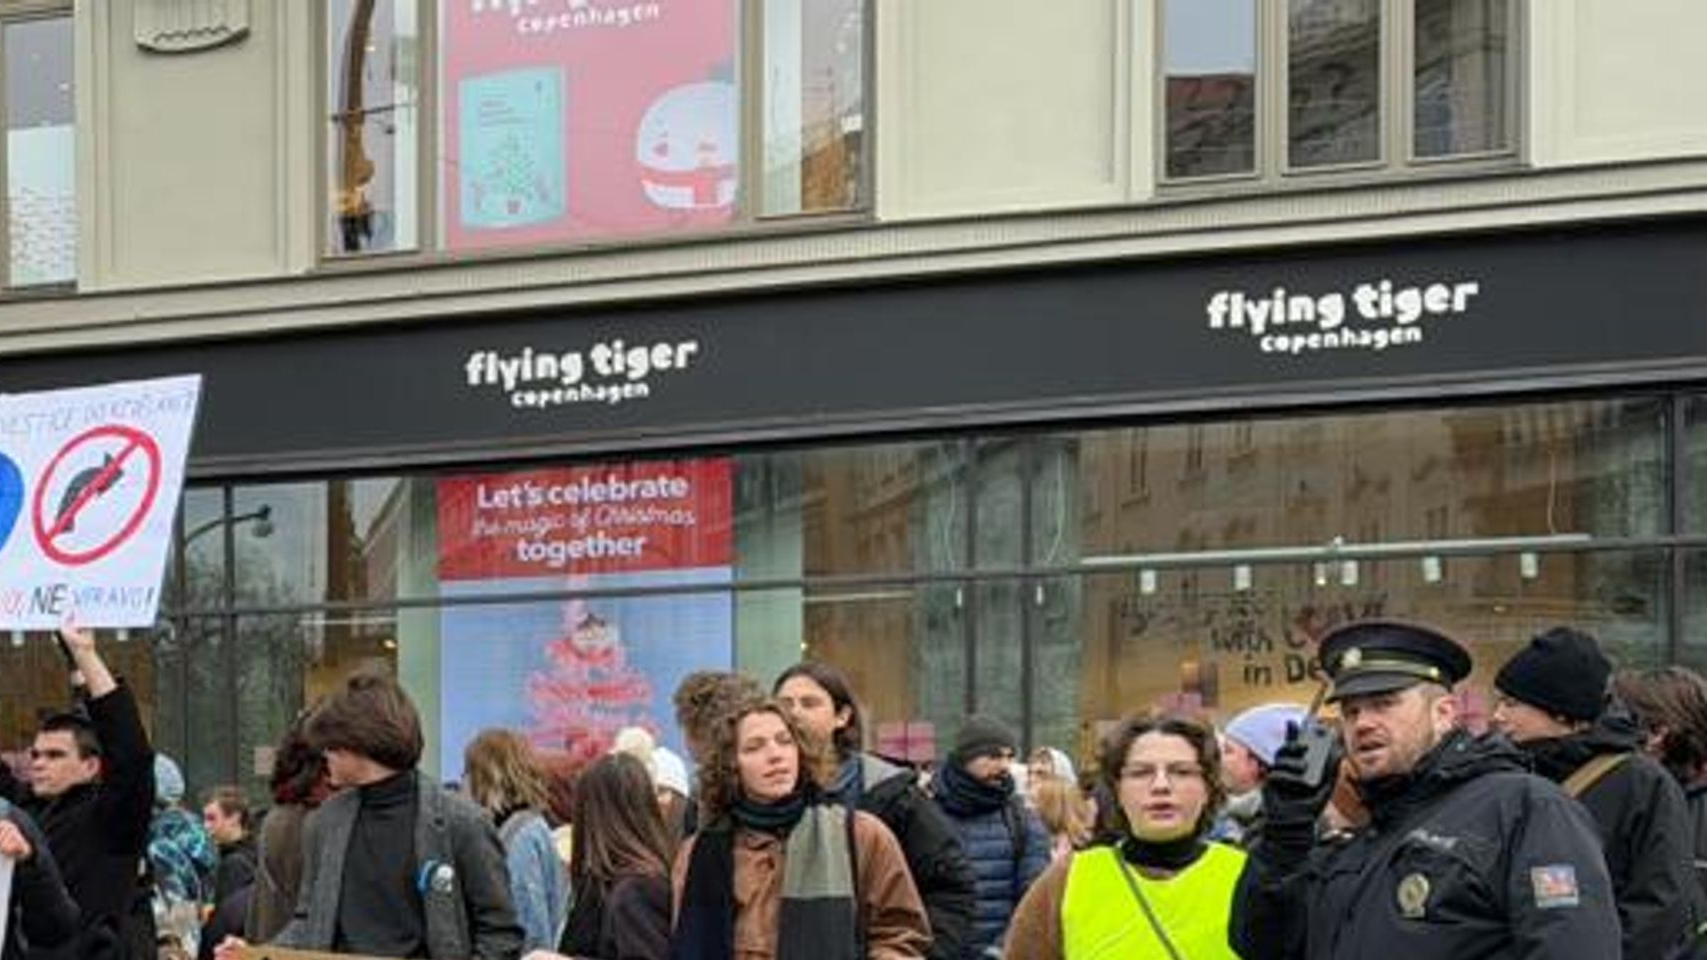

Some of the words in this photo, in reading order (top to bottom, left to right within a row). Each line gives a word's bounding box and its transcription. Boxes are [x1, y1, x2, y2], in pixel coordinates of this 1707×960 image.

[1207, 286, 1344, 334] flying
[1353, 280, 1480, 324] tiger
[1260, 325, 1423, 354] copenhagen
[465, 347, 583, 391] flying
[592, 339, 698, 380] tiger
[511, 381, 649, 408] copenhagen
[477, 479, 543, 509] Let's
[548, 473, 689, 505] celebrate
[517, 530, 647, 567] together
[29, 583, 67, 615] NE
